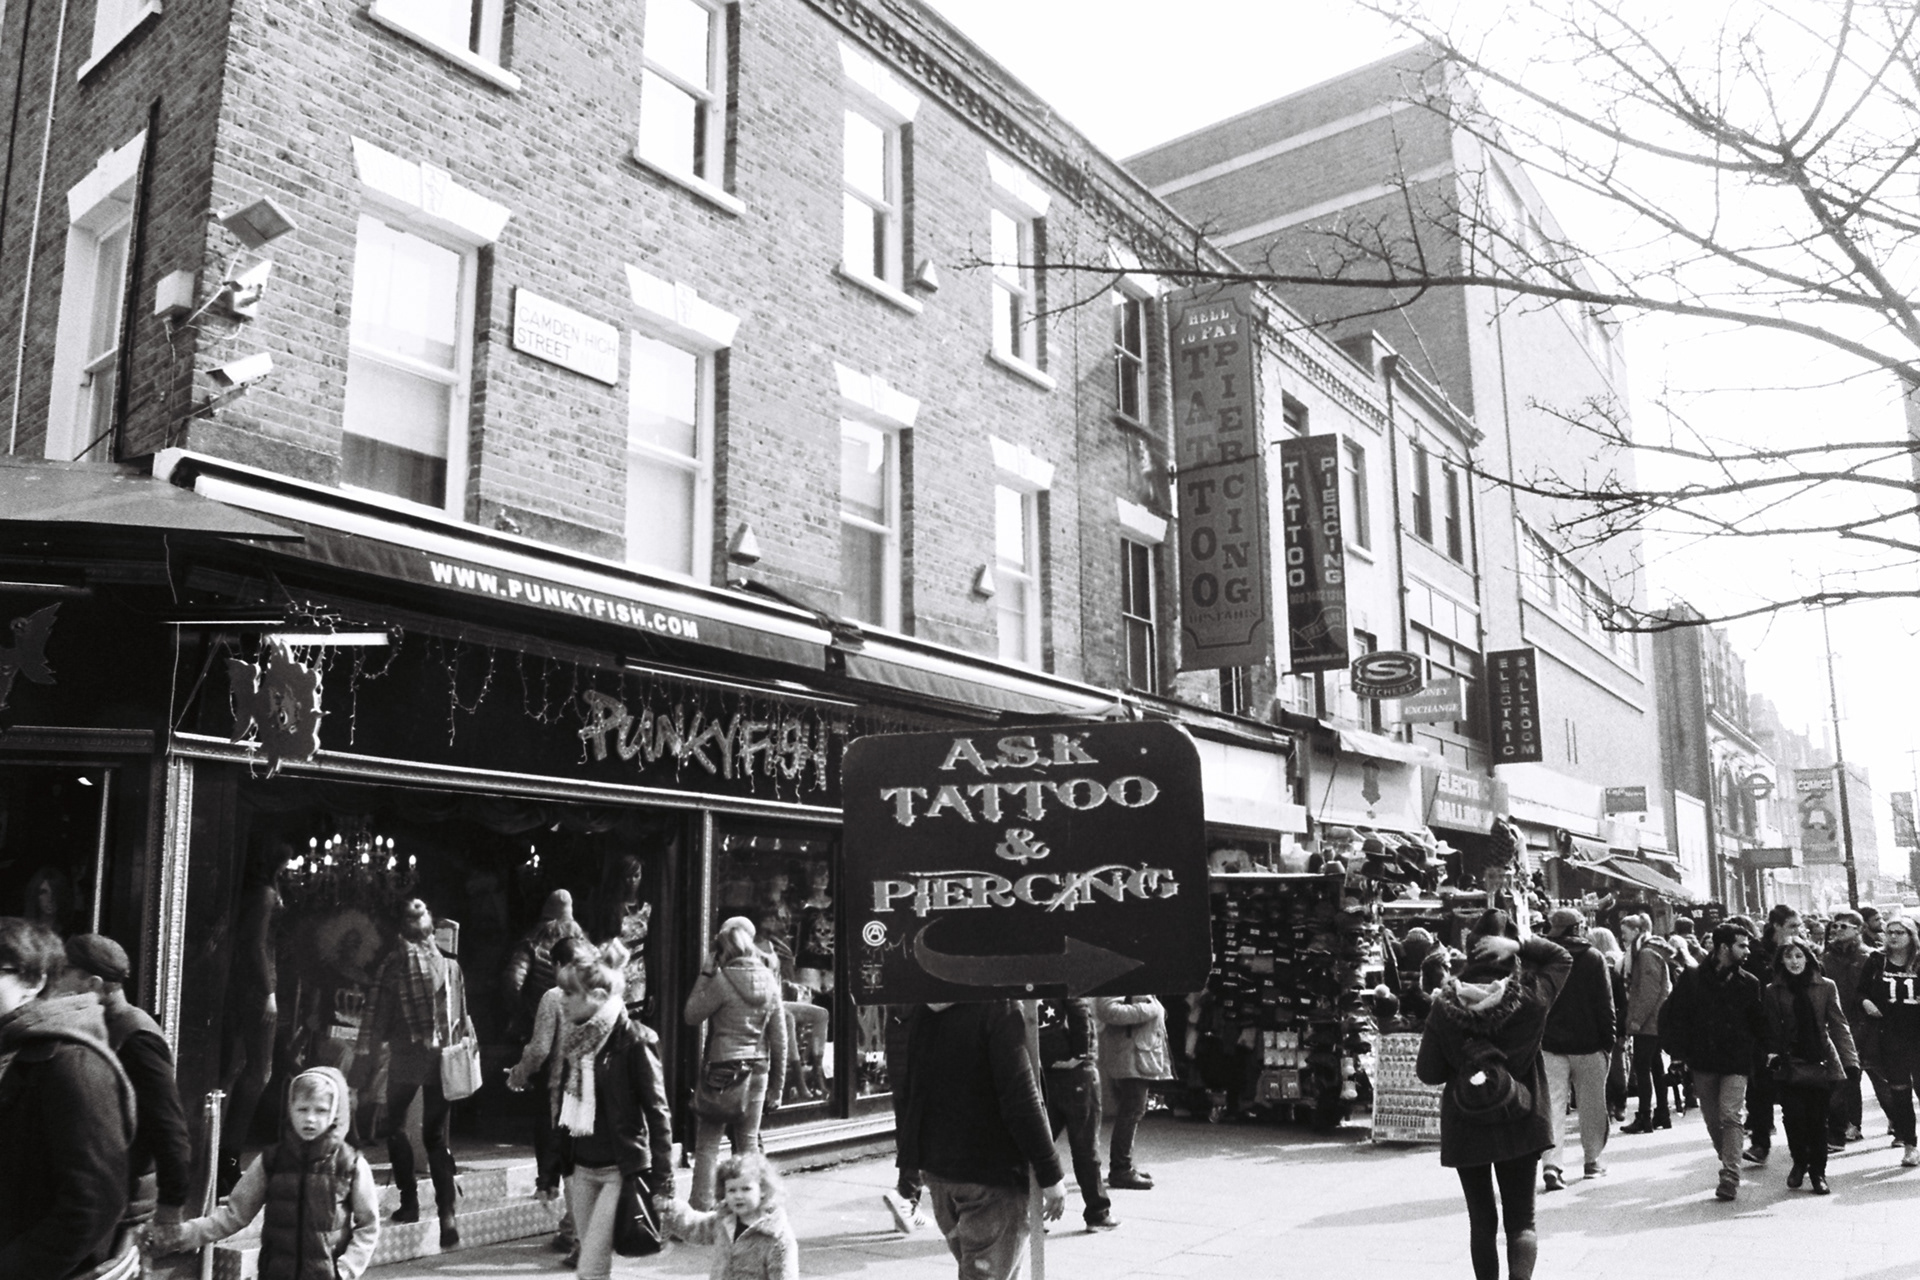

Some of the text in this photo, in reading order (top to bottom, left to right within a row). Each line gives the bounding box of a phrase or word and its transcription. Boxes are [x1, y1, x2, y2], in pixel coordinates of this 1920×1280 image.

[519, 306, 580, 343] CAMDEN
[1188, 309, 1229, 326] HELL
[1202, 321, 1237, 339] PAY
[517, 327, 572, 361] STREET
[1181, 345, 1219, 608] TATTOO
[1213, 341, 1251, 604] PIERCING
[1284, 461, 1305, 587] TATTOO
[1320, 457, 1342, 584] PIERCING
[430, 561, 699, 639] WWW.PUNKYFISH.COM
[1355, 683, 1414, 697] SKECHERS
[1404, 703, 1460, 715] EXCHANGE
[1499, 658, 1515, 756] ELECTRIC
[1517, 656, 1535, 755] BALLROOM
[880, 776, 1160, 826] TATTOO
[996, 828, 1050, 865] &
[873, 865, 1179, 917] PIERCING
